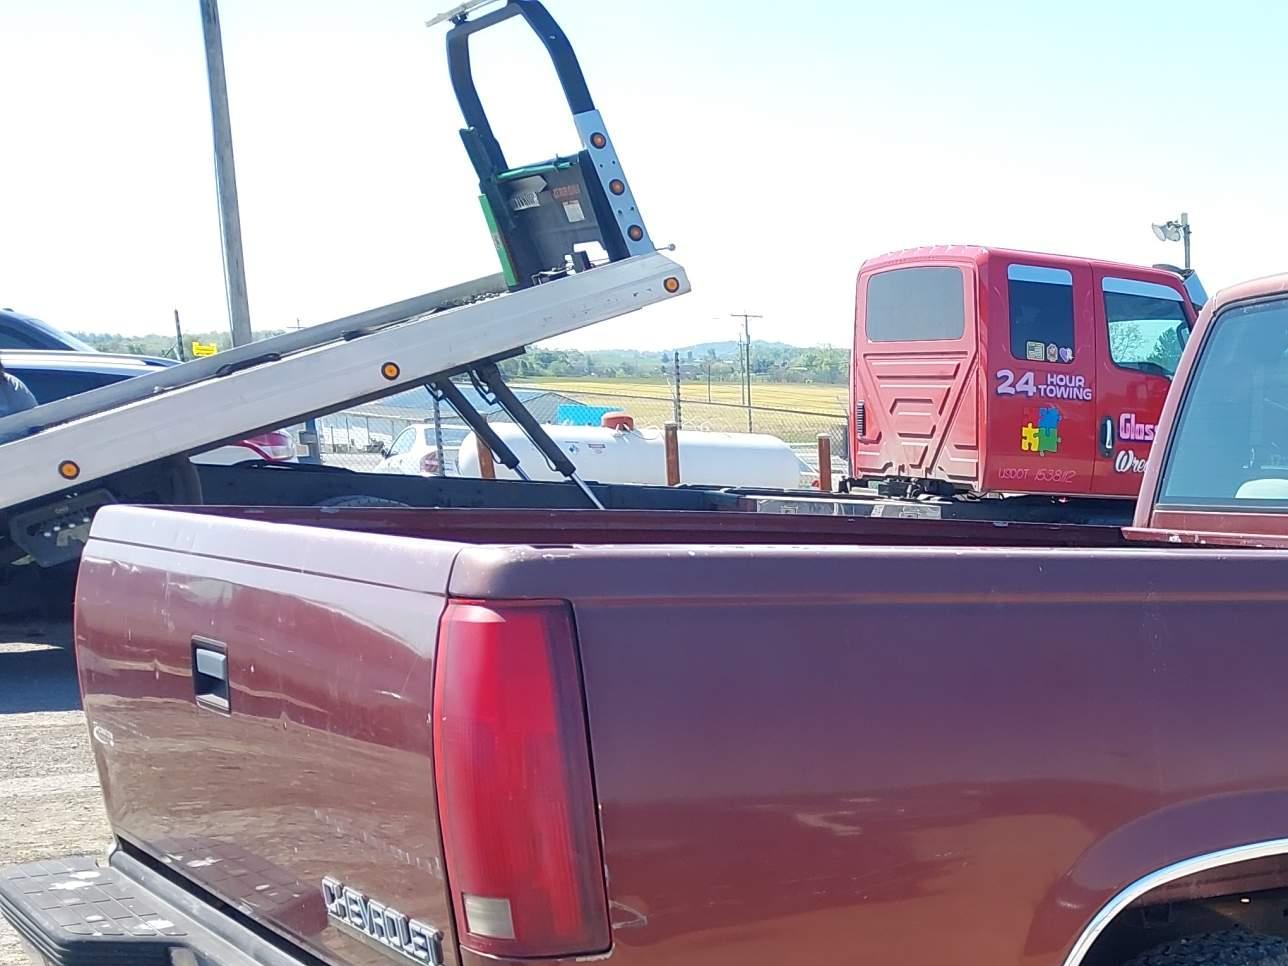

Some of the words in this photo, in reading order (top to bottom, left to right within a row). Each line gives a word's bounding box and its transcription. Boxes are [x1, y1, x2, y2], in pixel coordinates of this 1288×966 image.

[996, 369, 1037, 396] 24
[1047, 373, 1085, 388] HOUR
[1038, 385, 1093, 401] TOWING
[1115, 450, 1147, 473] Wre
[998, 467, 1031, 480] USDOT
